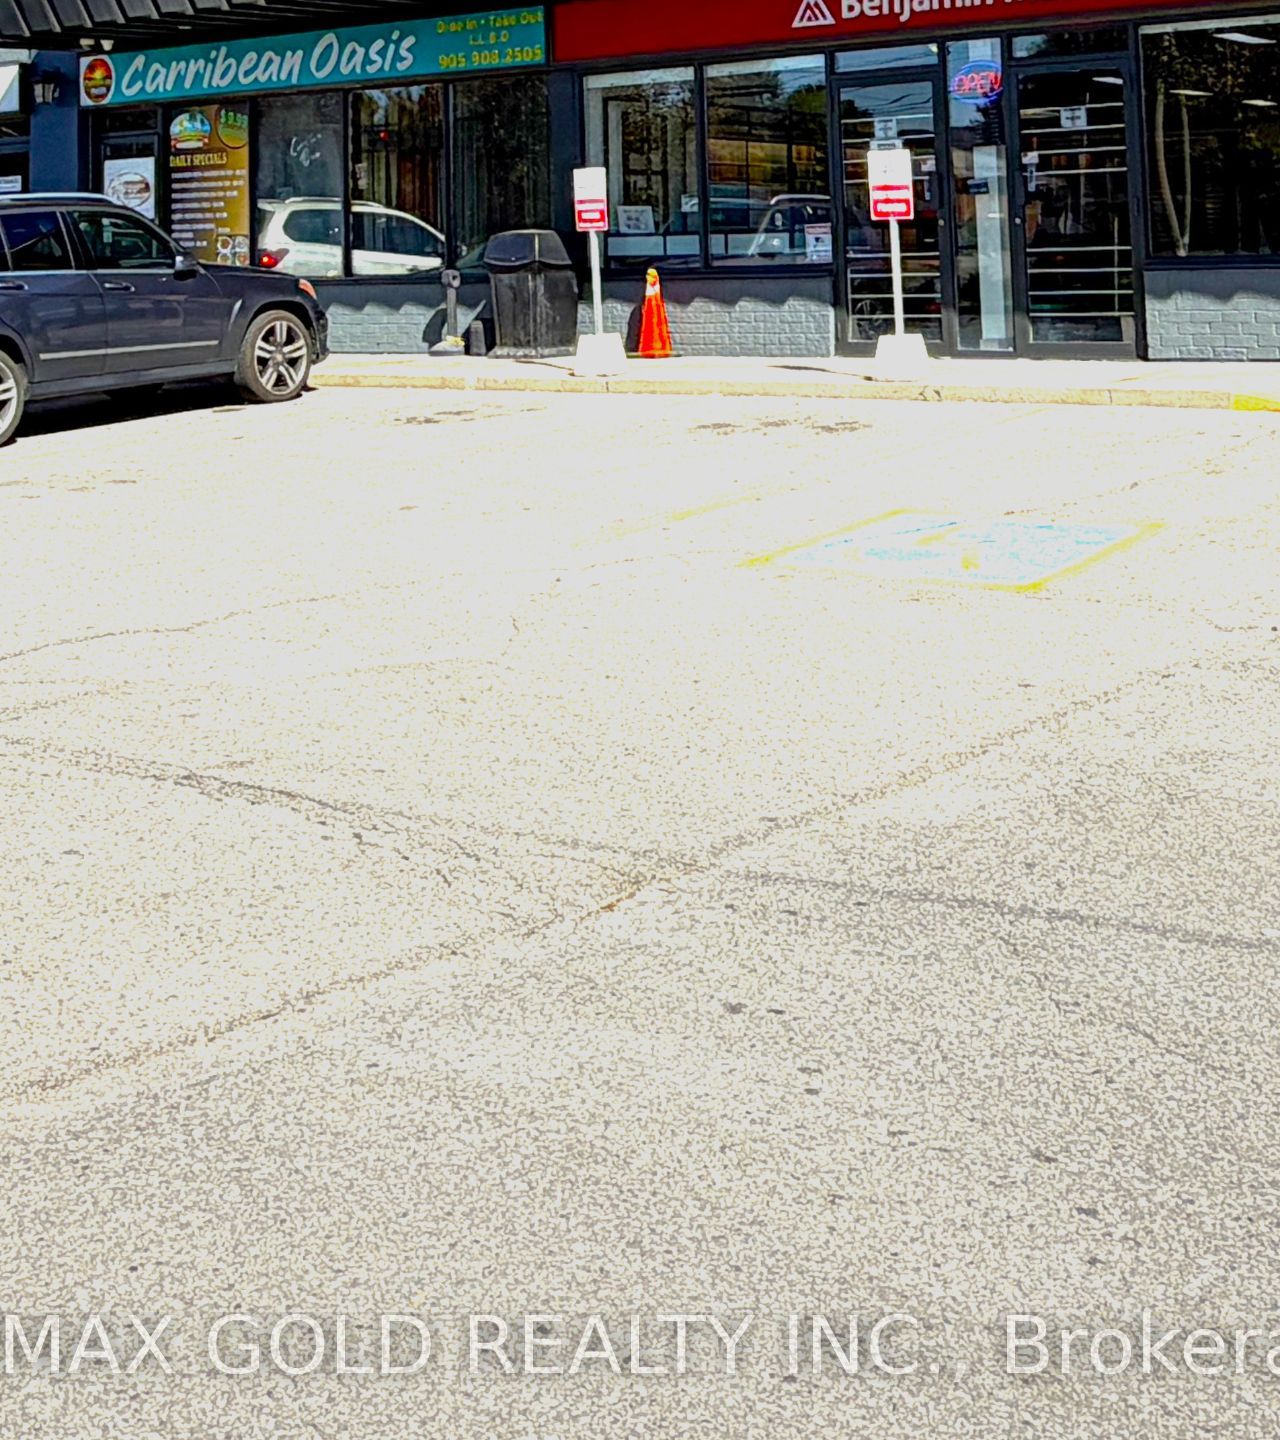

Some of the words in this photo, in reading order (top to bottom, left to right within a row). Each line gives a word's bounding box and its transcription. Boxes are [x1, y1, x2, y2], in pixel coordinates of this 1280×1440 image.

[120, 46, 303, 98] Carribean
[309, 30, 417, 80] Oasis
[953, 71, 1001, 94] OPEN
[169, 154, 192, 167] DAILY
[193, 151, 228, 165] SPECIALS
